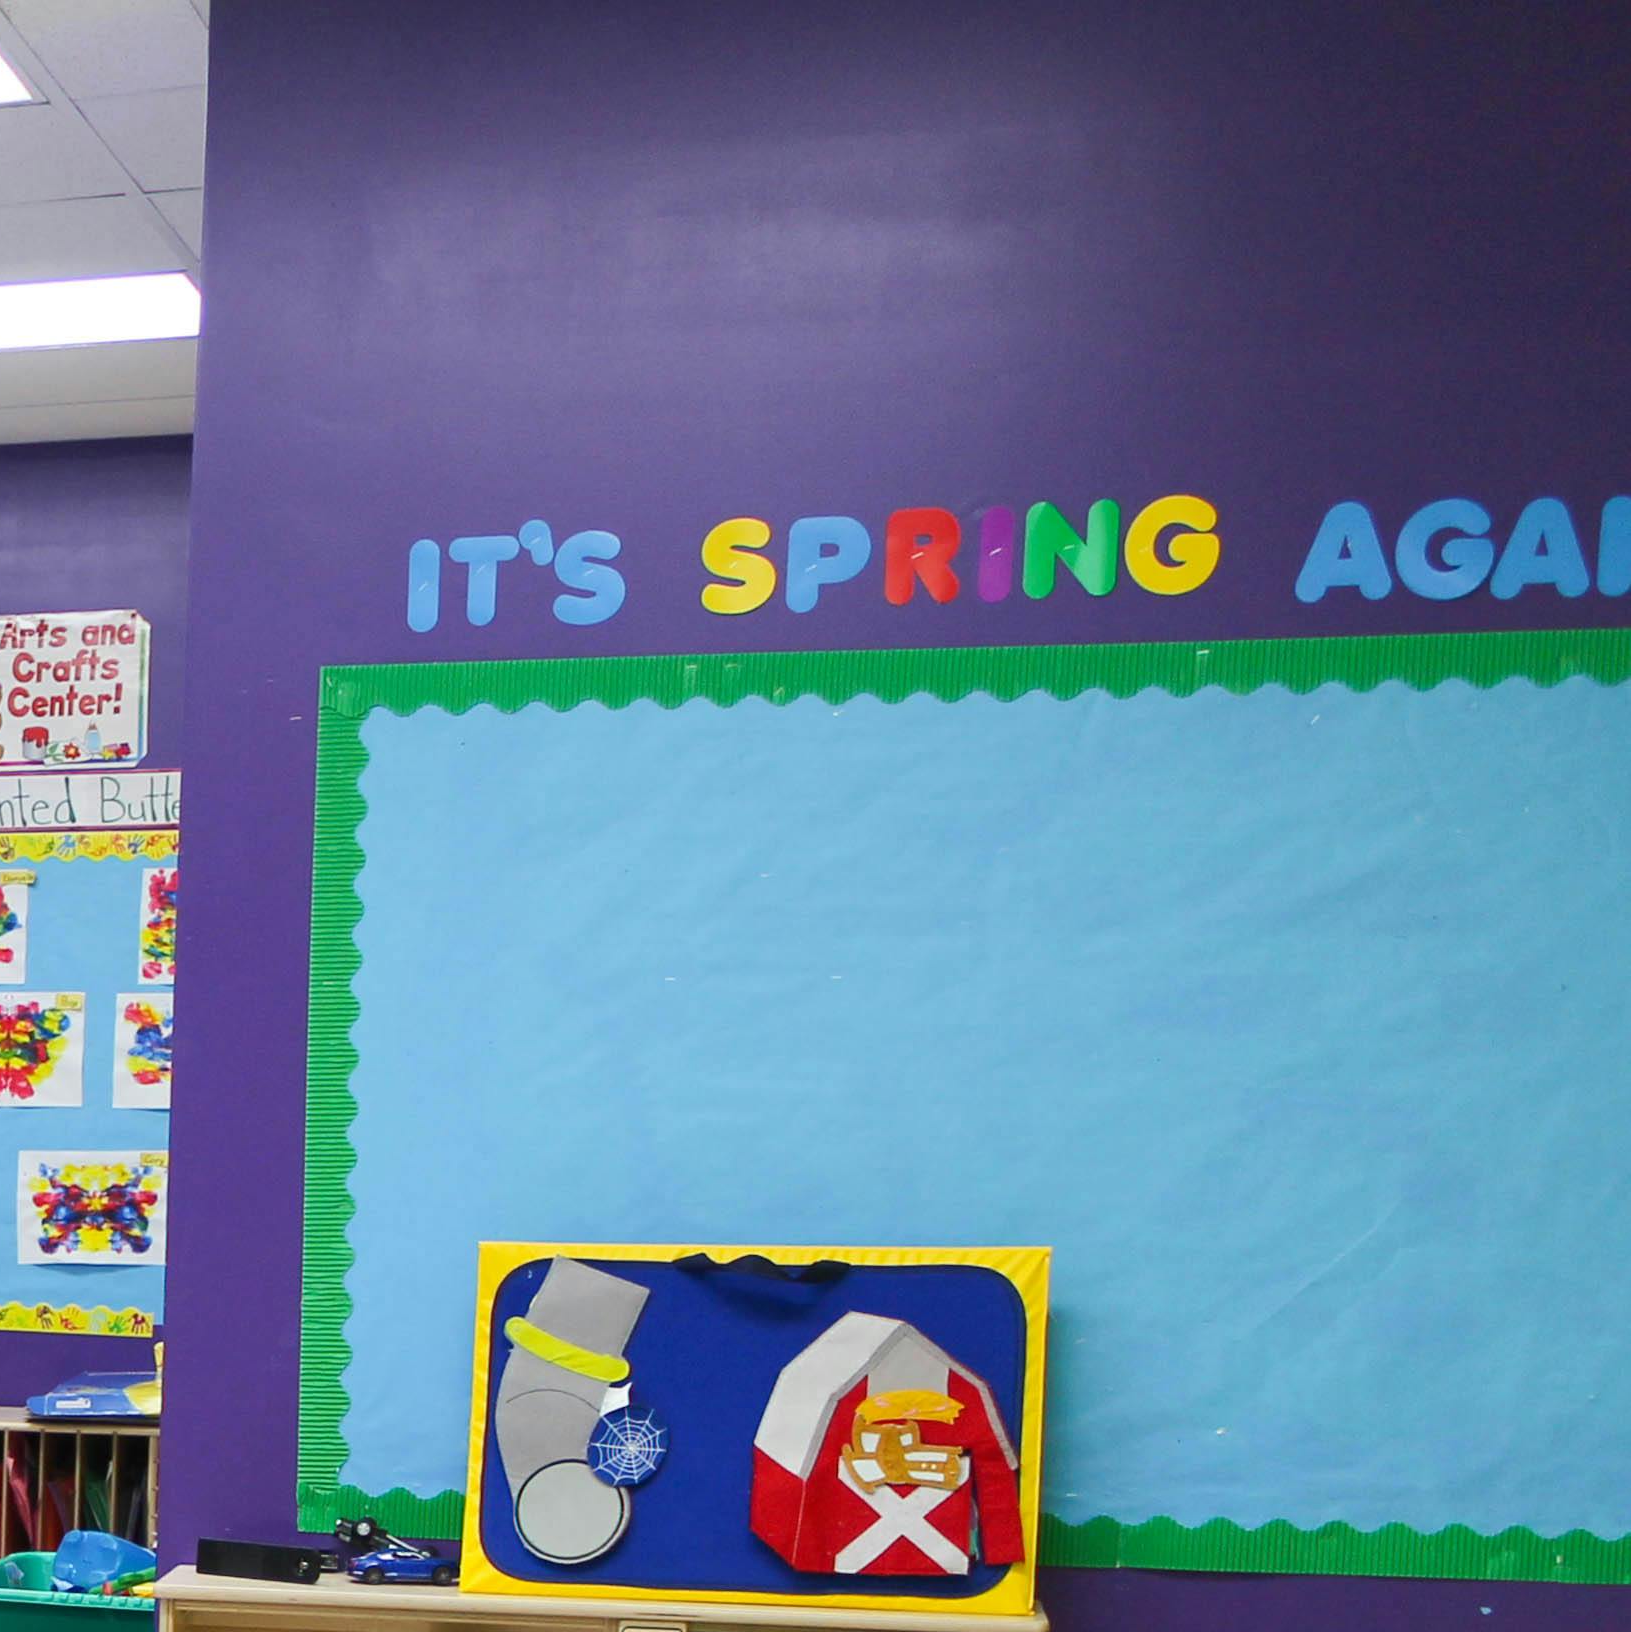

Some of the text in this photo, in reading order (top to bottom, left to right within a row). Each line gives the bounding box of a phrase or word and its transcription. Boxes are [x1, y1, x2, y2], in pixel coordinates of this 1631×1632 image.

[408, 518, 626, 633] IT'S
[701, 493, 1221, 614] SPRING
[81, 619, 137, 647] and
[12, 652, 120, 681] Crafts
[7, 682, 123, 719] Center!
